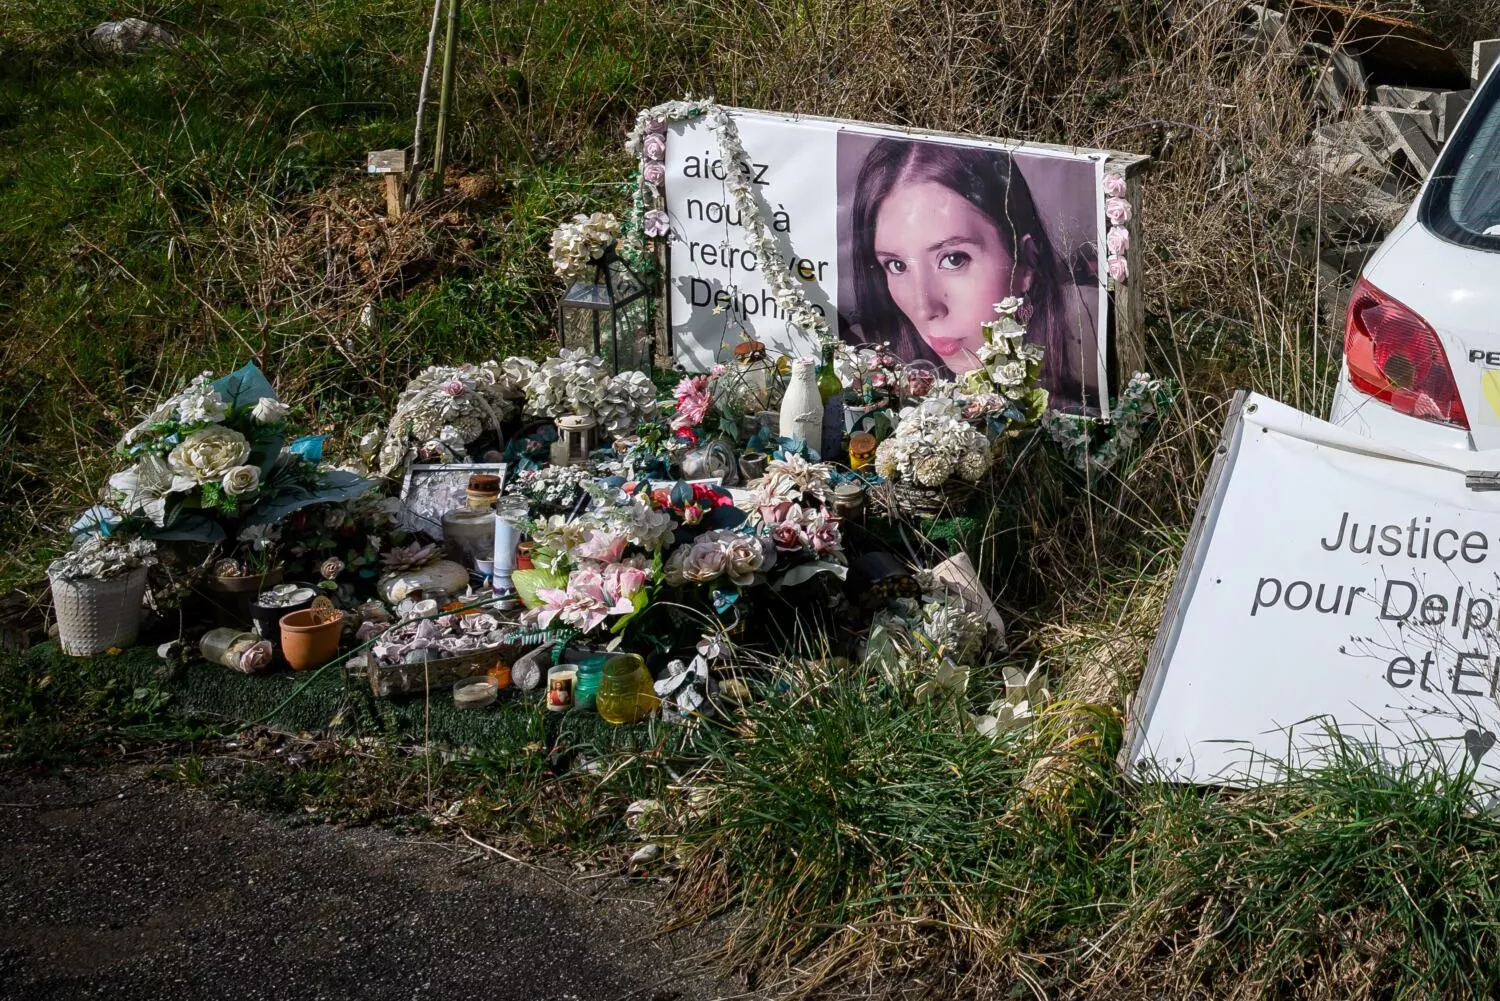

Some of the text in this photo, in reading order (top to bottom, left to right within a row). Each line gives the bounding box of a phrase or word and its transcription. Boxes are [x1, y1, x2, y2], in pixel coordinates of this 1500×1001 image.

[687, 199, 791, 232] nou à
[690, 241, 829, 281] retroer
[691, 277, 826, 322] Delph
[1321, 511, 1489, 565] Justice
[1250, 577, 1366, 617] pour
[1386, 650, 1433, 693] et
